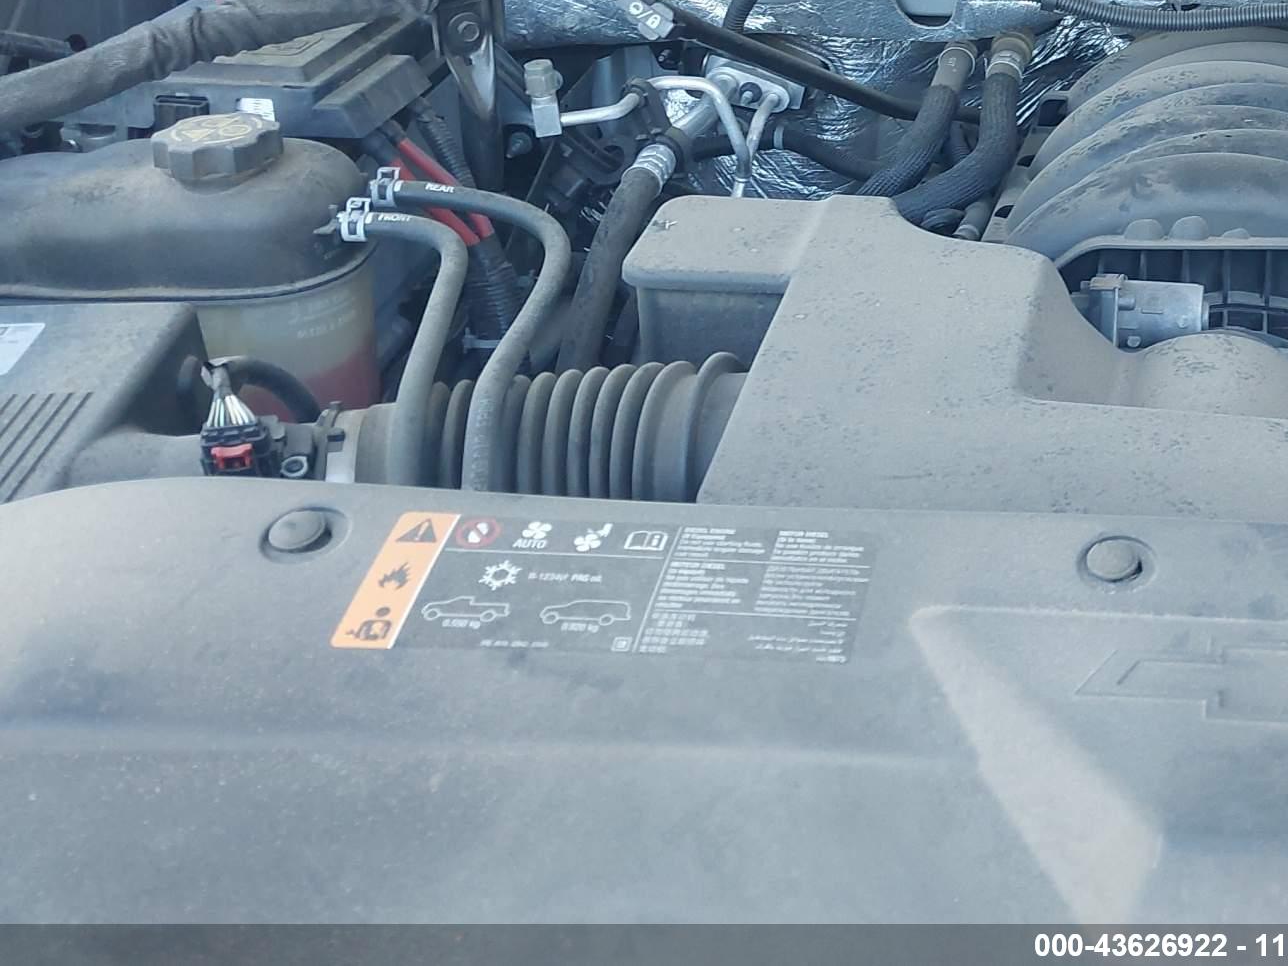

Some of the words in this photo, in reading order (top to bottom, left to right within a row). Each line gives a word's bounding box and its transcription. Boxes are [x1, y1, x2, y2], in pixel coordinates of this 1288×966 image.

[424, 182, 455, 194] REAR
[377, 213, 412, 222] FRONT
[512, 537, 547, 549] AUTO
